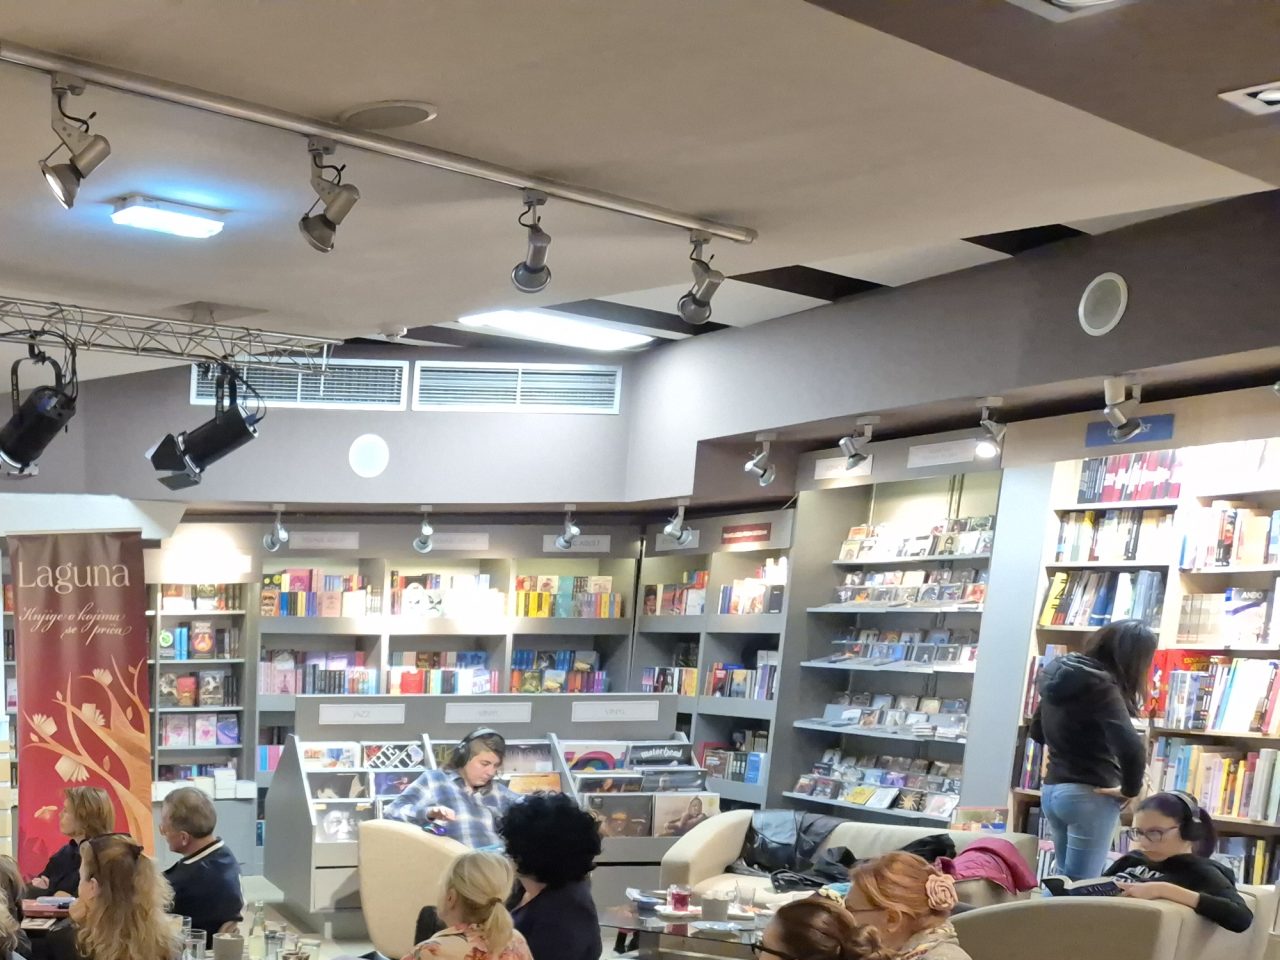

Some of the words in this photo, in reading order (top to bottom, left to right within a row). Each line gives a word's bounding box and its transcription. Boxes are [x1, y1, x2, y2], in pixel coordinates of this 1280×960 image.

[18, 561, 131, 595] Laguna
[18, 607, 64, 633] Knjige
[77, 602, 126, 633] kojima
[60, 626, 78, 640] se
